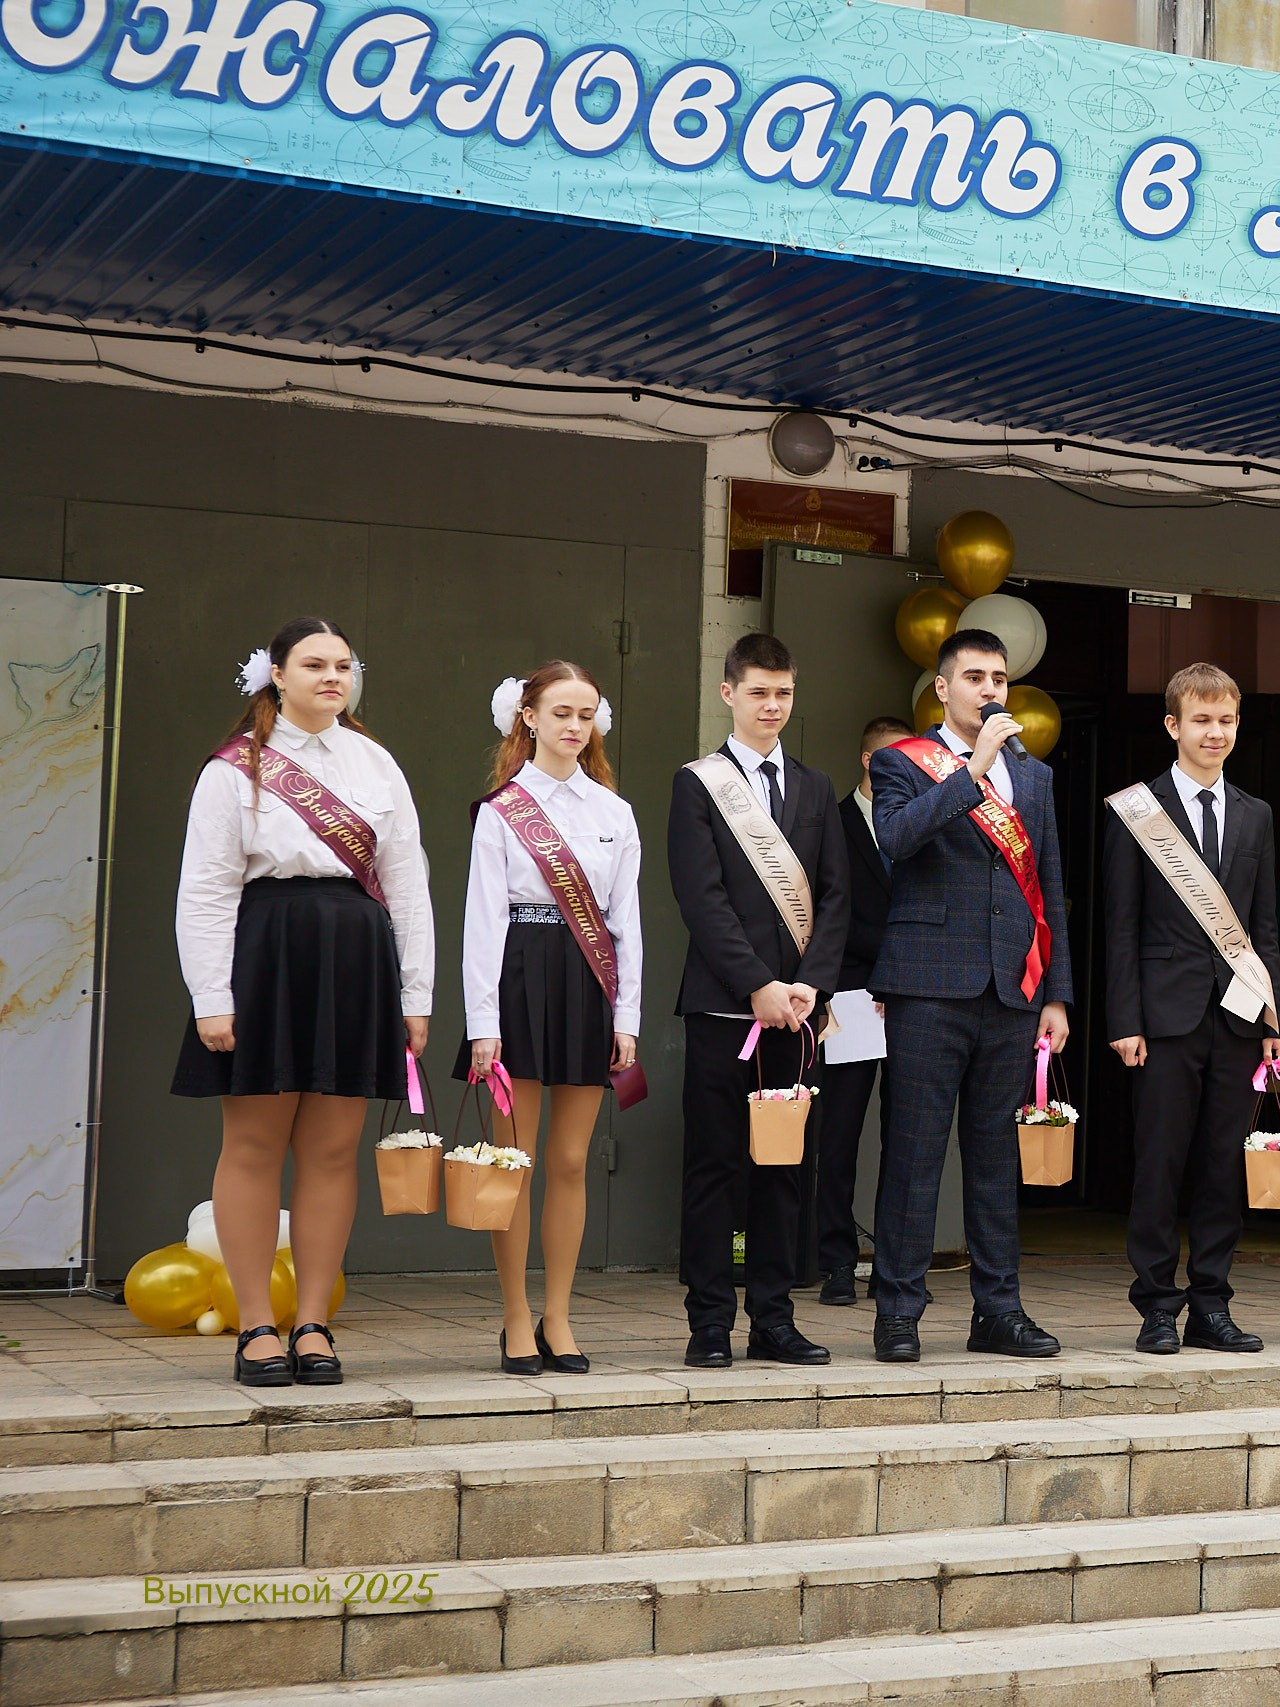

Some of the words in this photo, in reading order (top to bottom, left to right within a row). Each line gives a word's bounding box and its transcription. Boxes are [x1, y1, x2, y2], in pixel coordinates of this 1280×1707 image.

[1116, 137, 1207, 241] в
[524, 819, 598, 945] Выпускница
[742, 815, 810, 930] Выпускник
[1144, 819, 1223, 921] Выпускник
